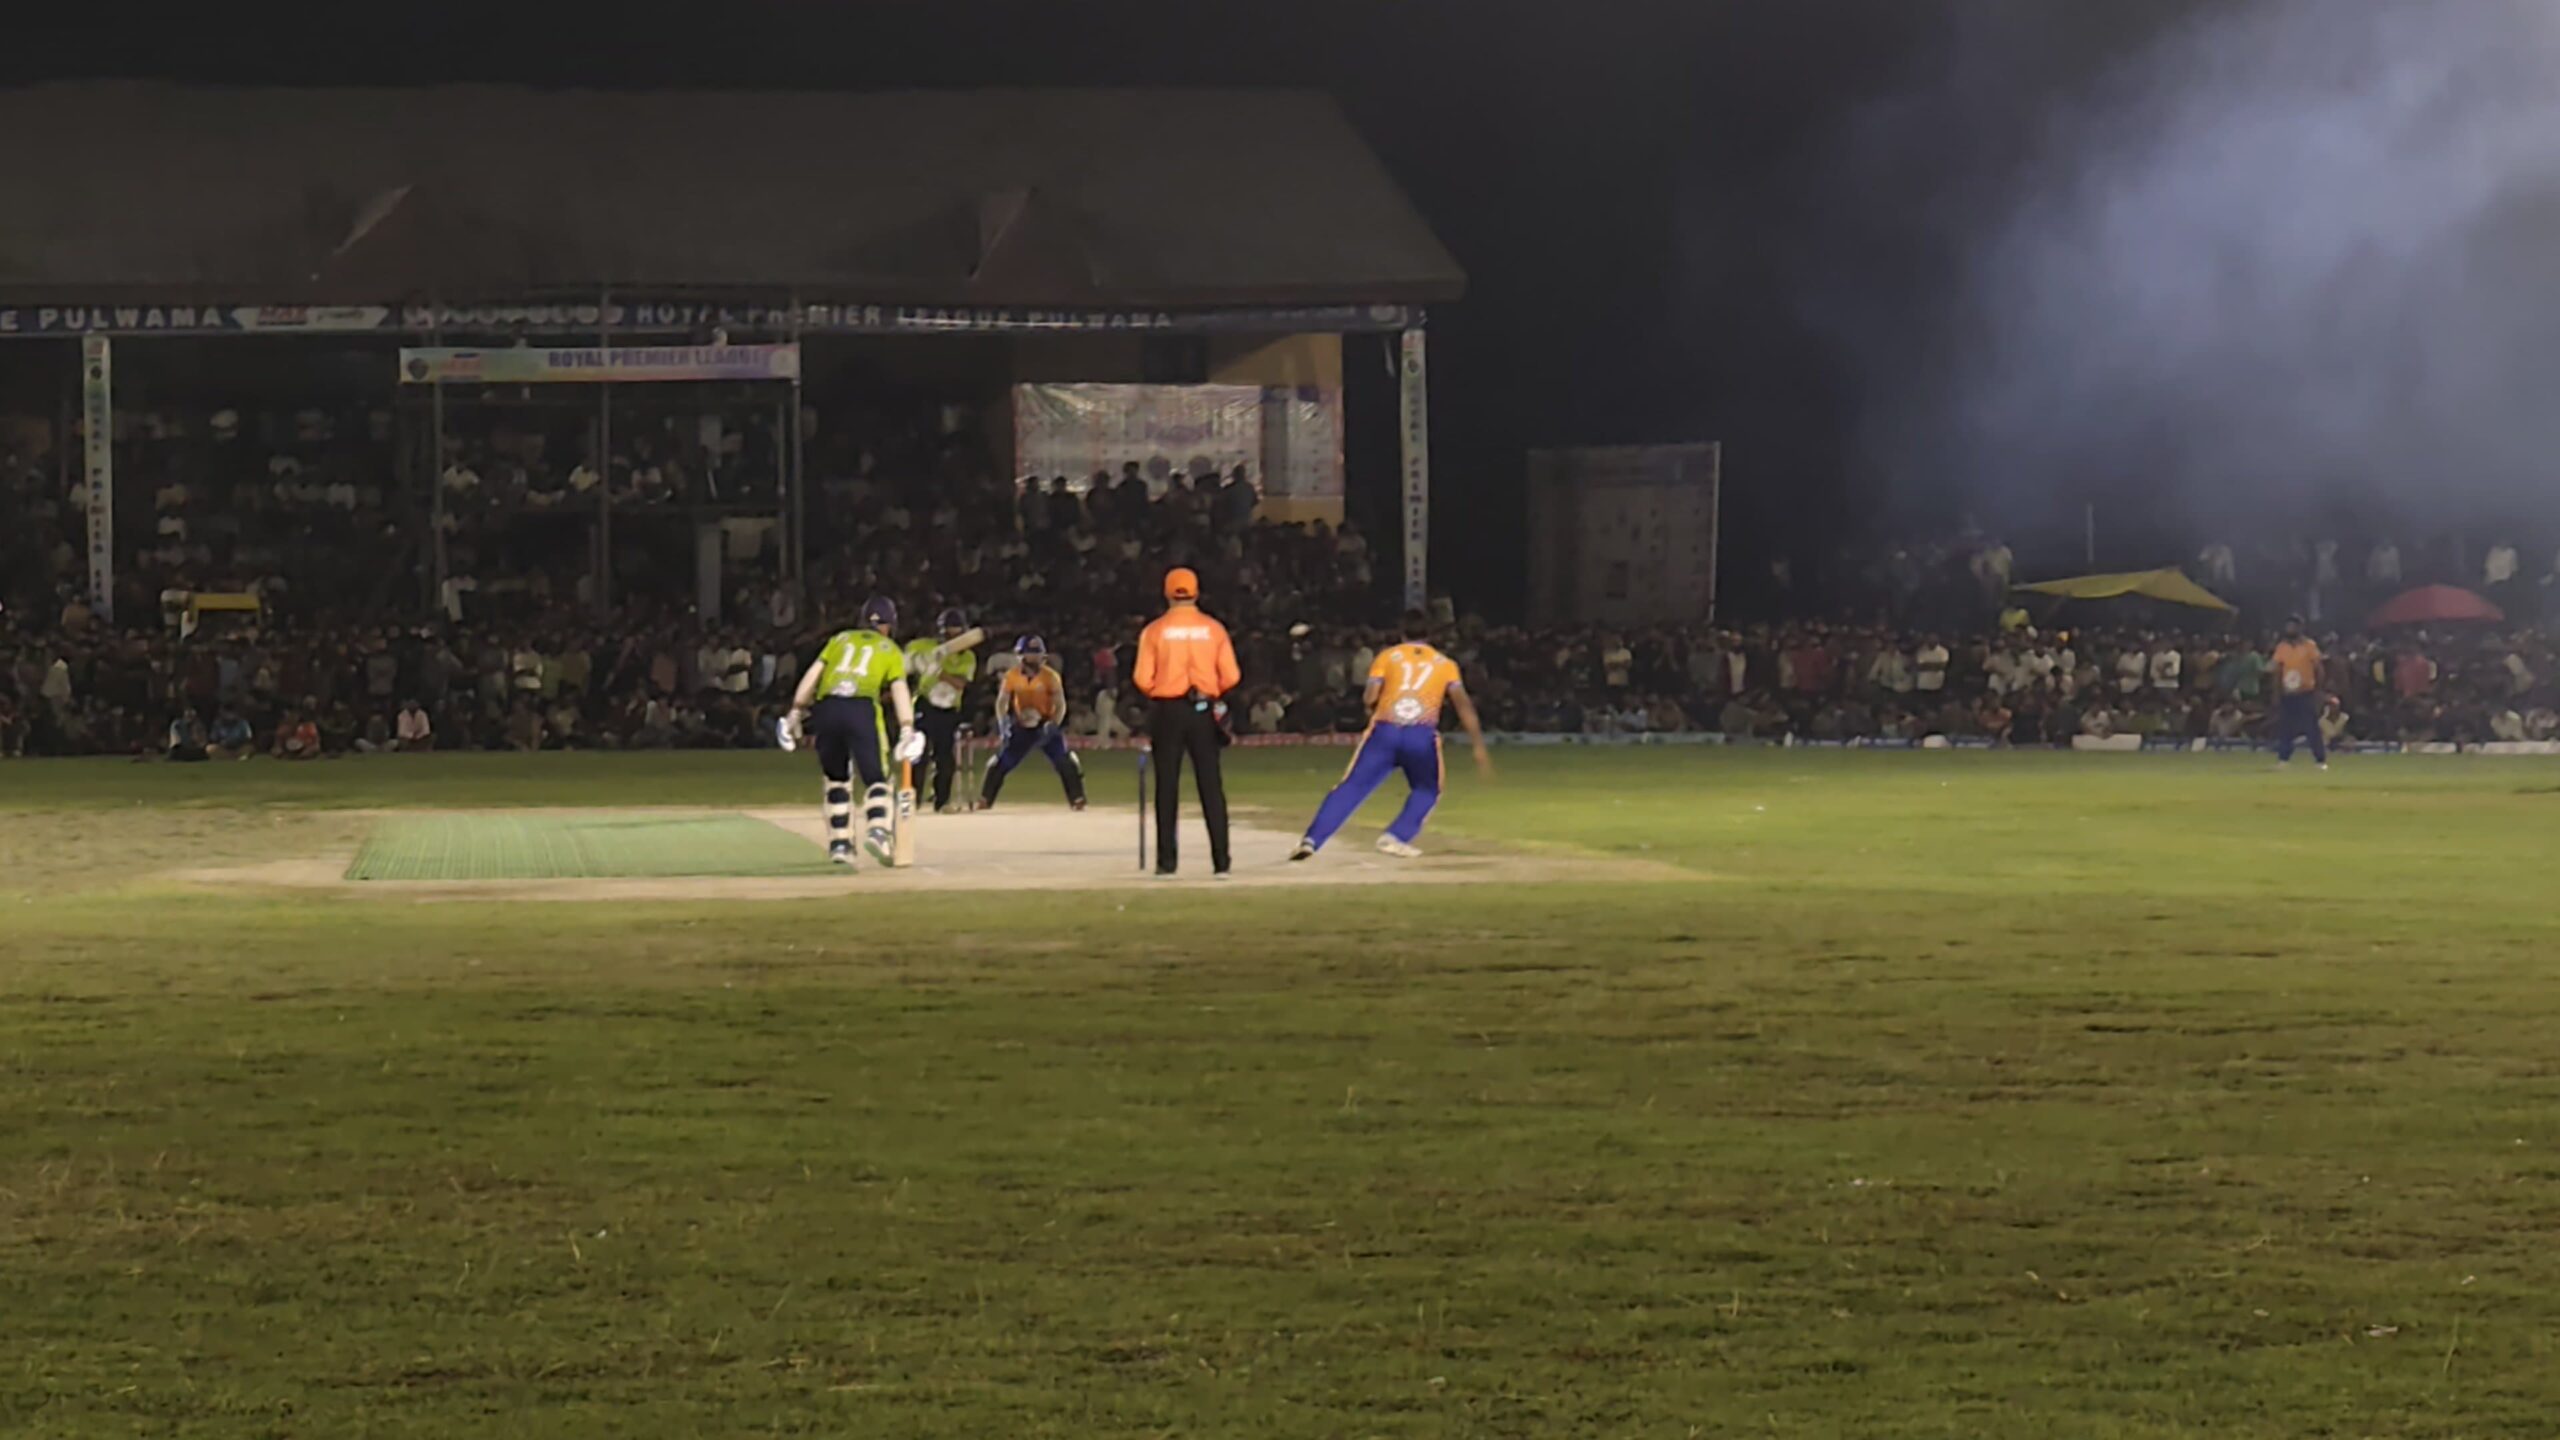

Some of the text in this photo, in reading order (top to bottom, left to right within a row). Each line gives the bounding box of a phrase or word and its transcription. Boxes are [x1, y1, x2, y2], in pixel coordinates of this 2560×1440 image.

[39, 306, 222, 329] PULWAMA
[549, 351, 604, 367] ROYAL
[829, 642, 874, 677] 11
[1399, 661, 1434, 691] 17
